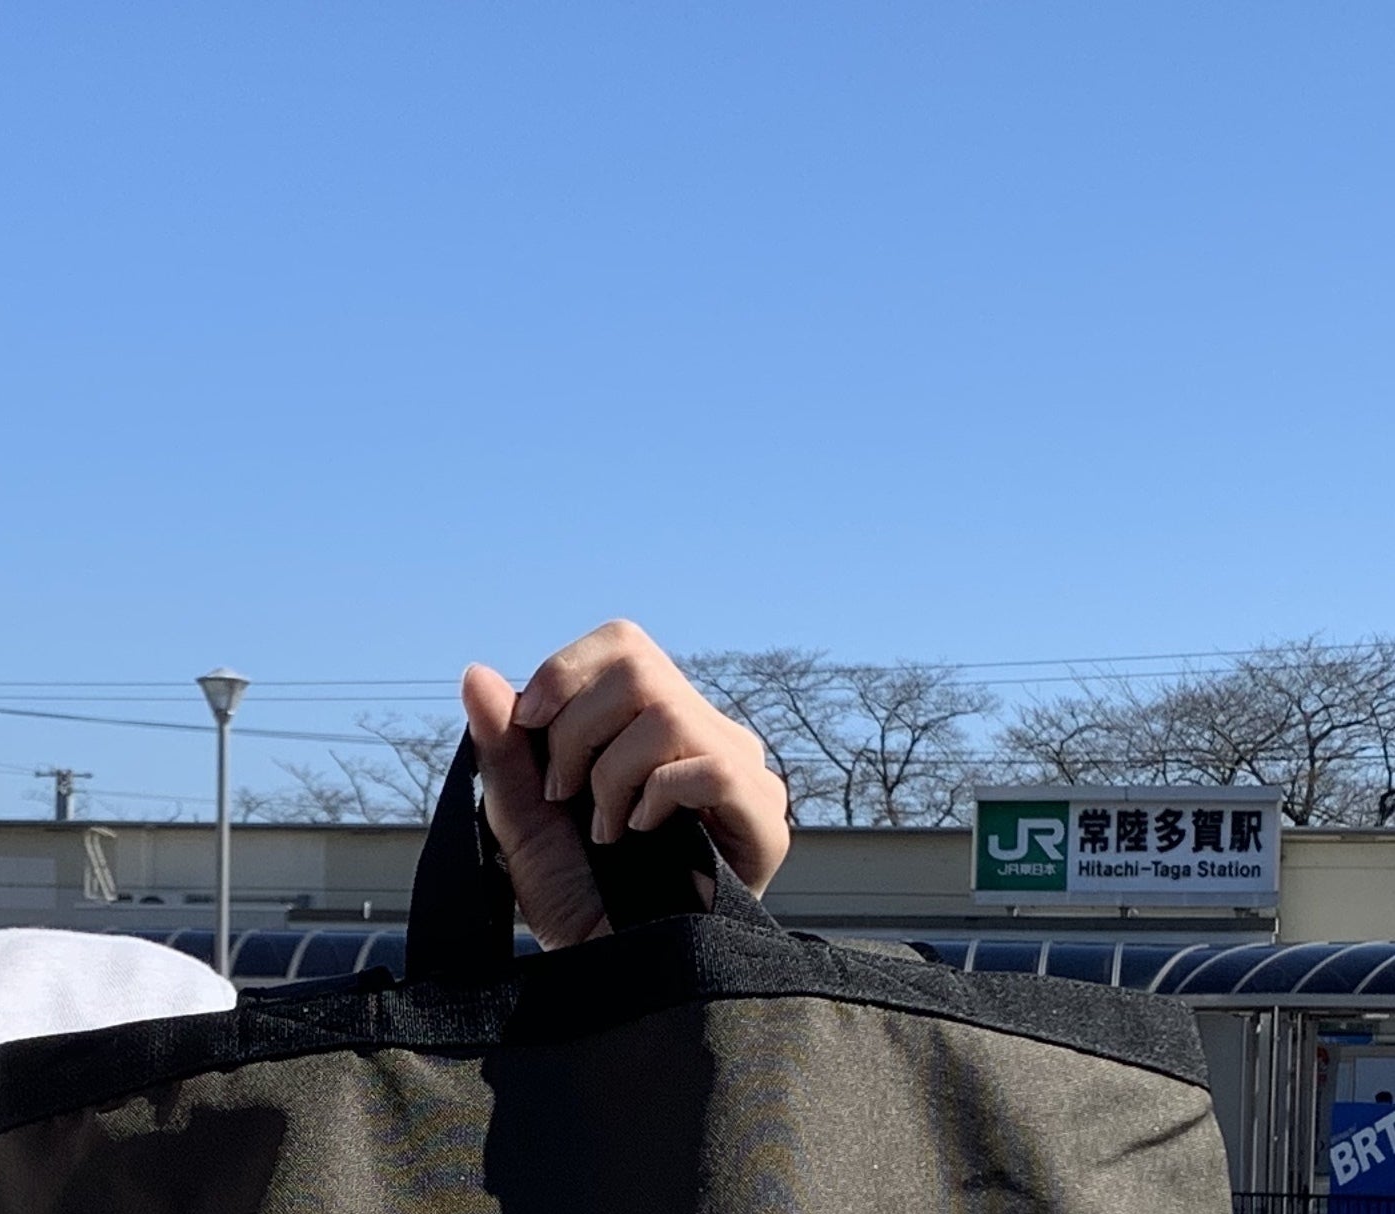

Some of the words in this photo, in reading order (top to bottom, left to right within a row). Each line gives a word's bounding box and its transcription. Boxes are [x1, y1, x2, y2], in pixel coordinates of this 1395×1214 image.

[988, 818, 1065, 860] JR
[1078, 808, 1263, 853] 常陸多賀駅
[997, 863, 1057, 876] JR東日本
[1079, 860, 1191, 880] Hitachi-Taga
[1197, 860, 1262, 878] Station
